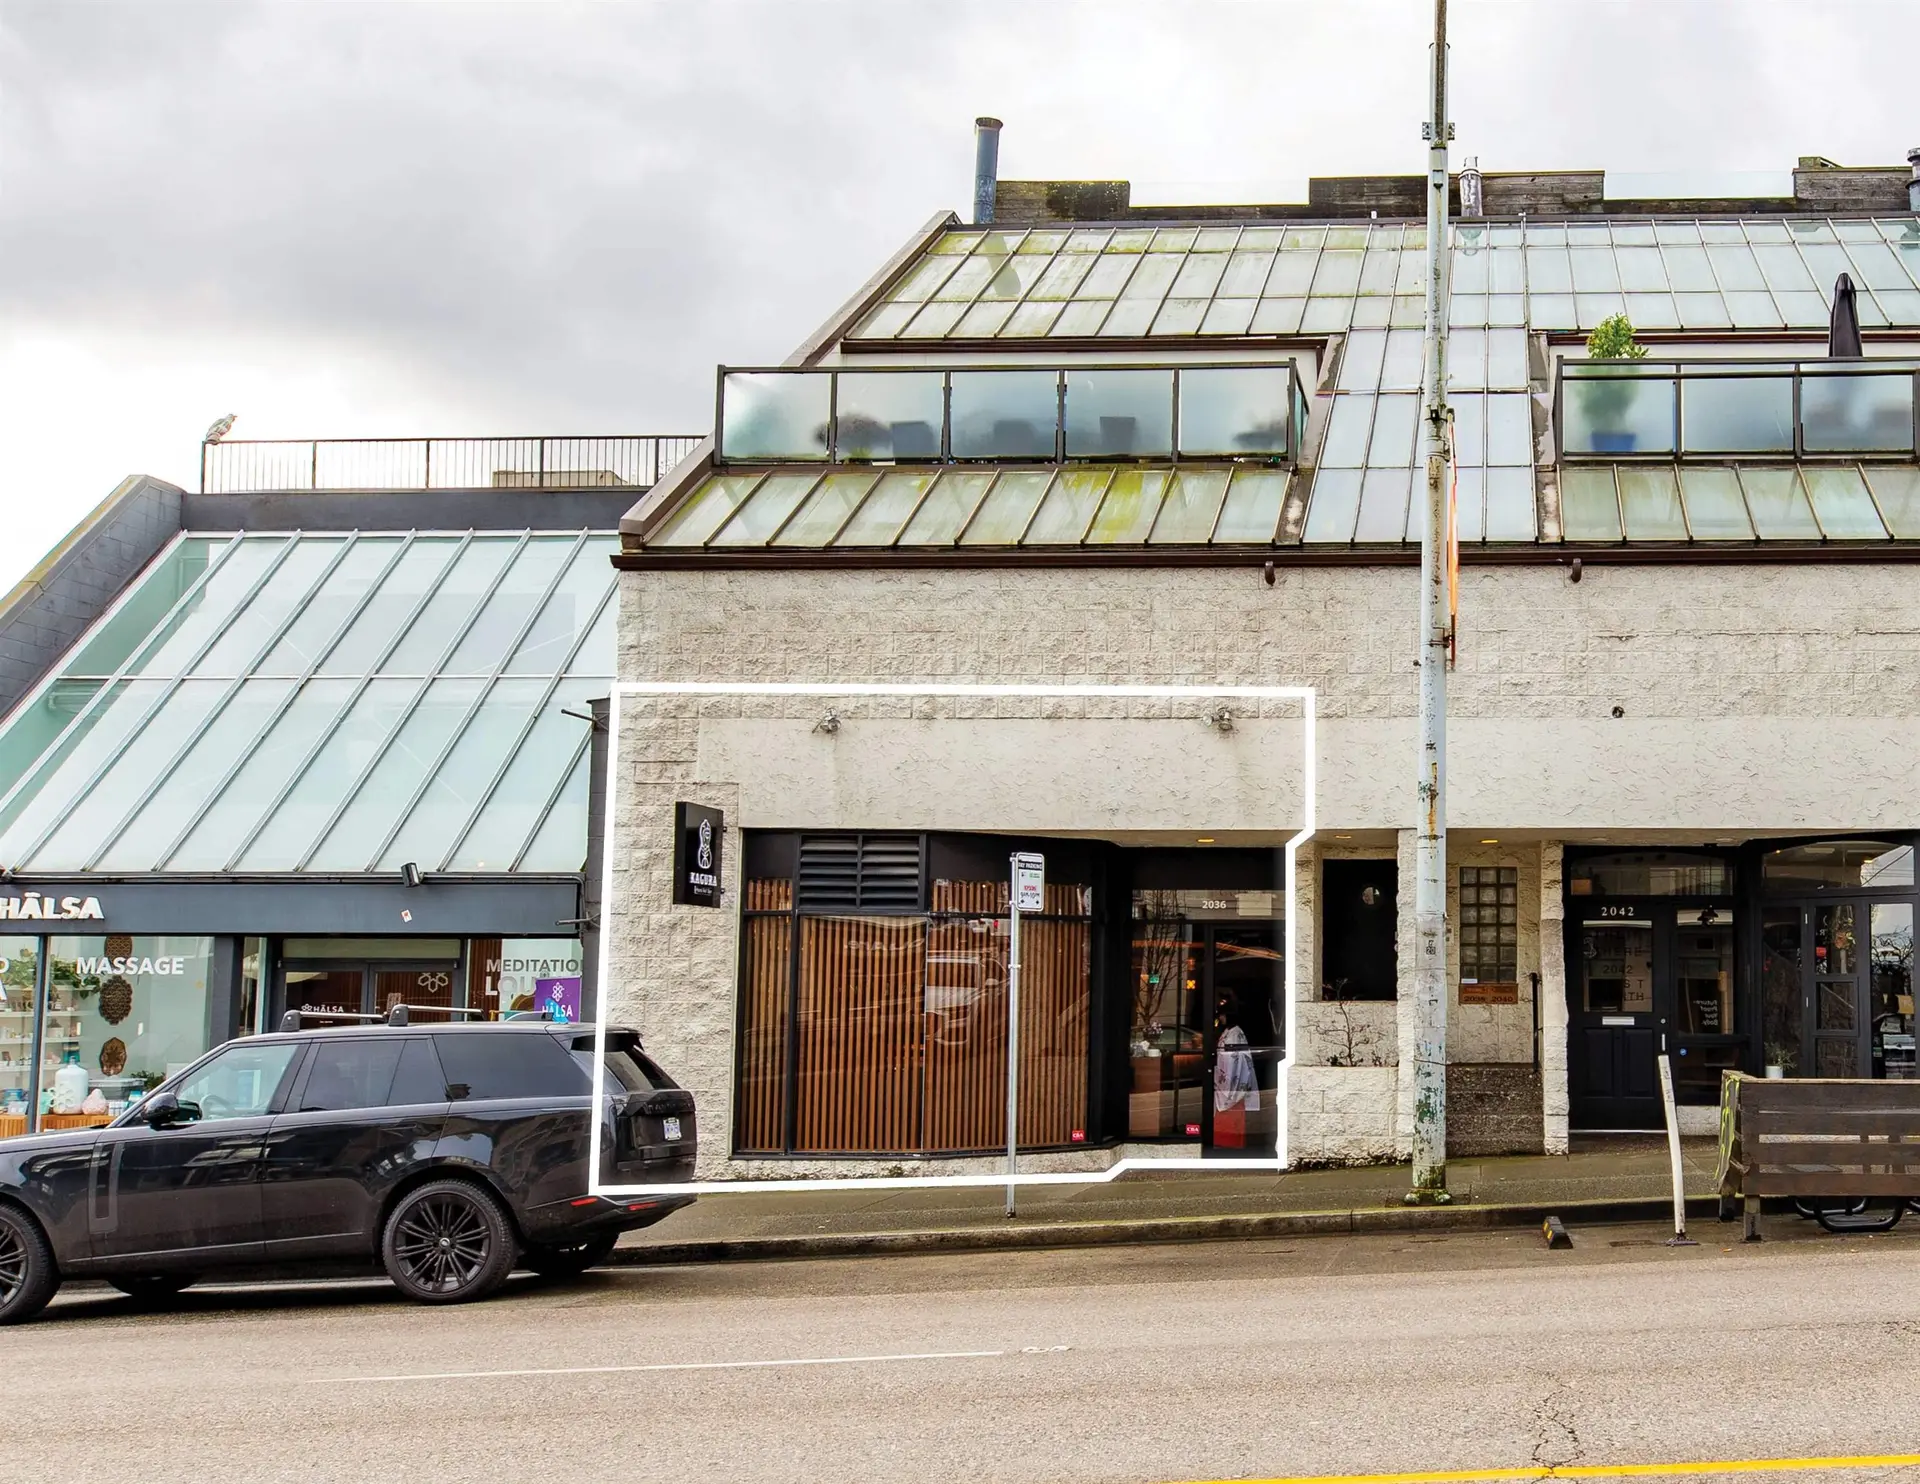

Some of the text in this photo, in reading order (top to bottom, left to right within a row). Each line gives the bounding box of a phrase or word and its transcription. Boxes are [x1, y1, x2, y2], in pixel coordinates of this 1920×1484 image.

[689, 872, 717, 886] KAGURA
[1202, 900, 1227, 909] 2036
[1601, 907, 1634, 916] 2042
[76, 957, 184, 975] MASSAGE
[486, 959, 580, 973] MEDITATIO
[1602, 964, 1633, 974] 2042
